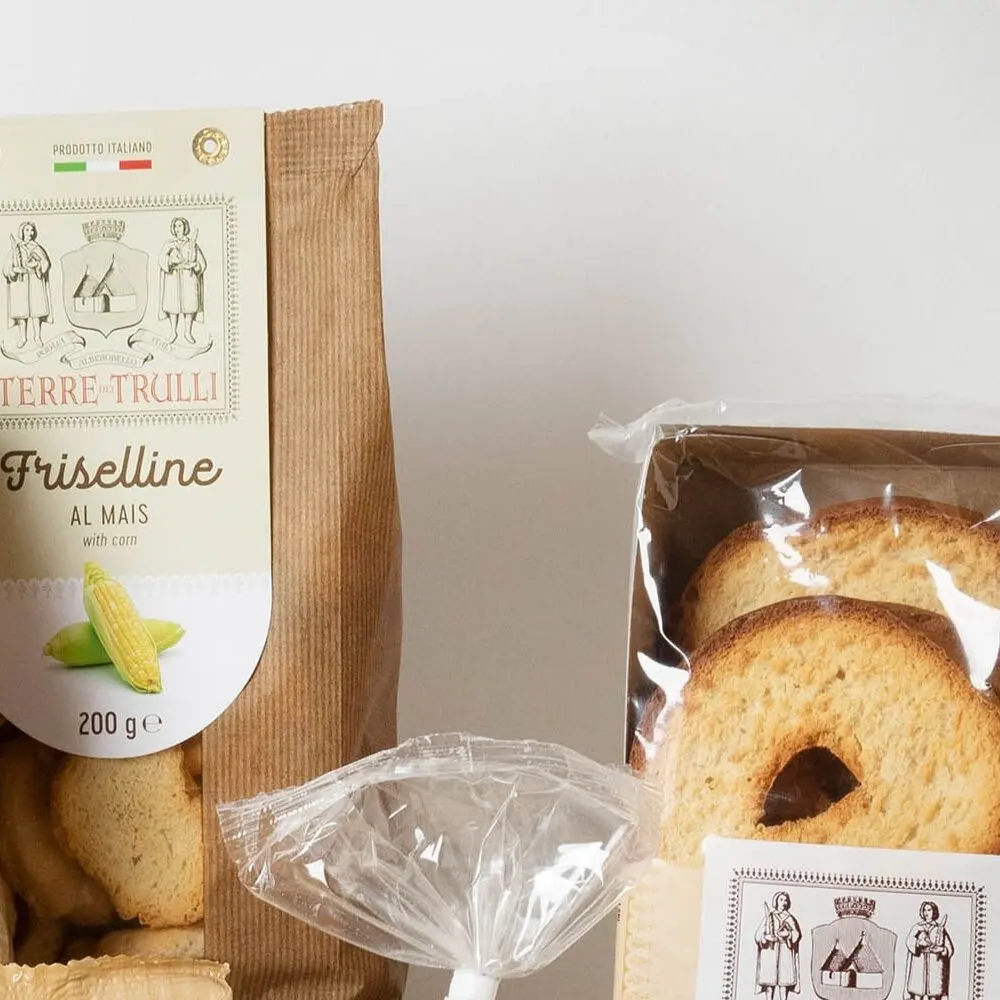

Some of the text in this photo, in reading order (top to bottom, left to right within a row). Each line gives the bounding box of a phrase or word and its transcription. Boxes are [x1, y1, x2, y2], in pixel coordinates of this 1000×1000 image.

[53, 141, 152, 156] PRODOTTO ITALIANO
[110, 371, 217, 404] TRULLI
[0, 445, 223, 492] Friselline
[70, 503, 149, 526] AL MAIS
[82, 532, 137, 548] with corn
[78, 711, 117, 736] 200
